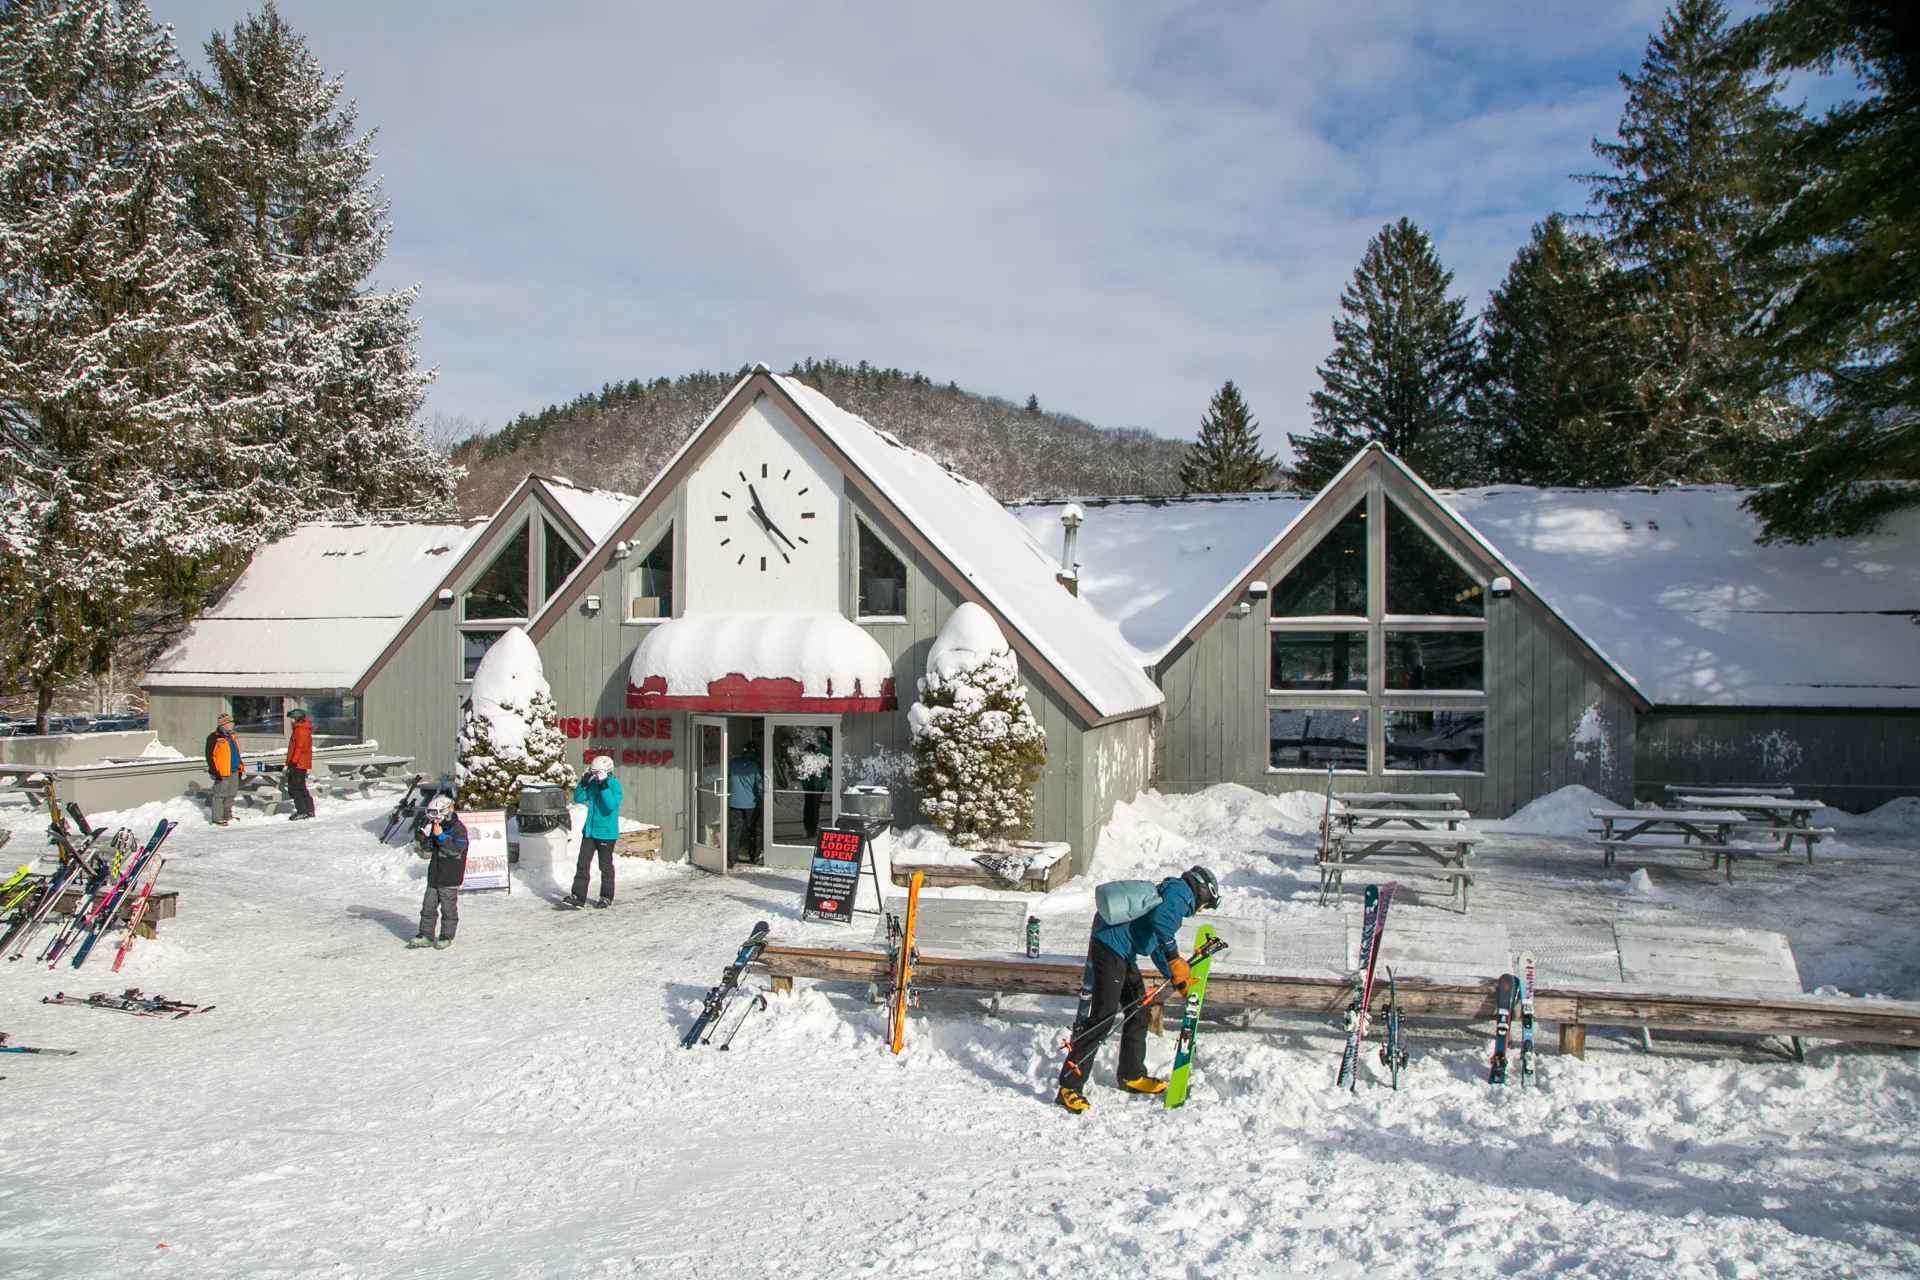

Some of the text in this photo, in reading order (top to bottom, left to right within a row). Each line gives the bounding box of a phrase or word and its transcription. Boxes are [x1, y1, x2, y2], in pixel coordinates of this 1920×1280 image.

[552, 717, 672, 739] UBHOUSE
[621, 749, 674, 765] SHOP
[823, 832, 859, 843] UPPER
[820, 841, 858, 852] LODGE
[822, 850, 853, 860] OPEN
